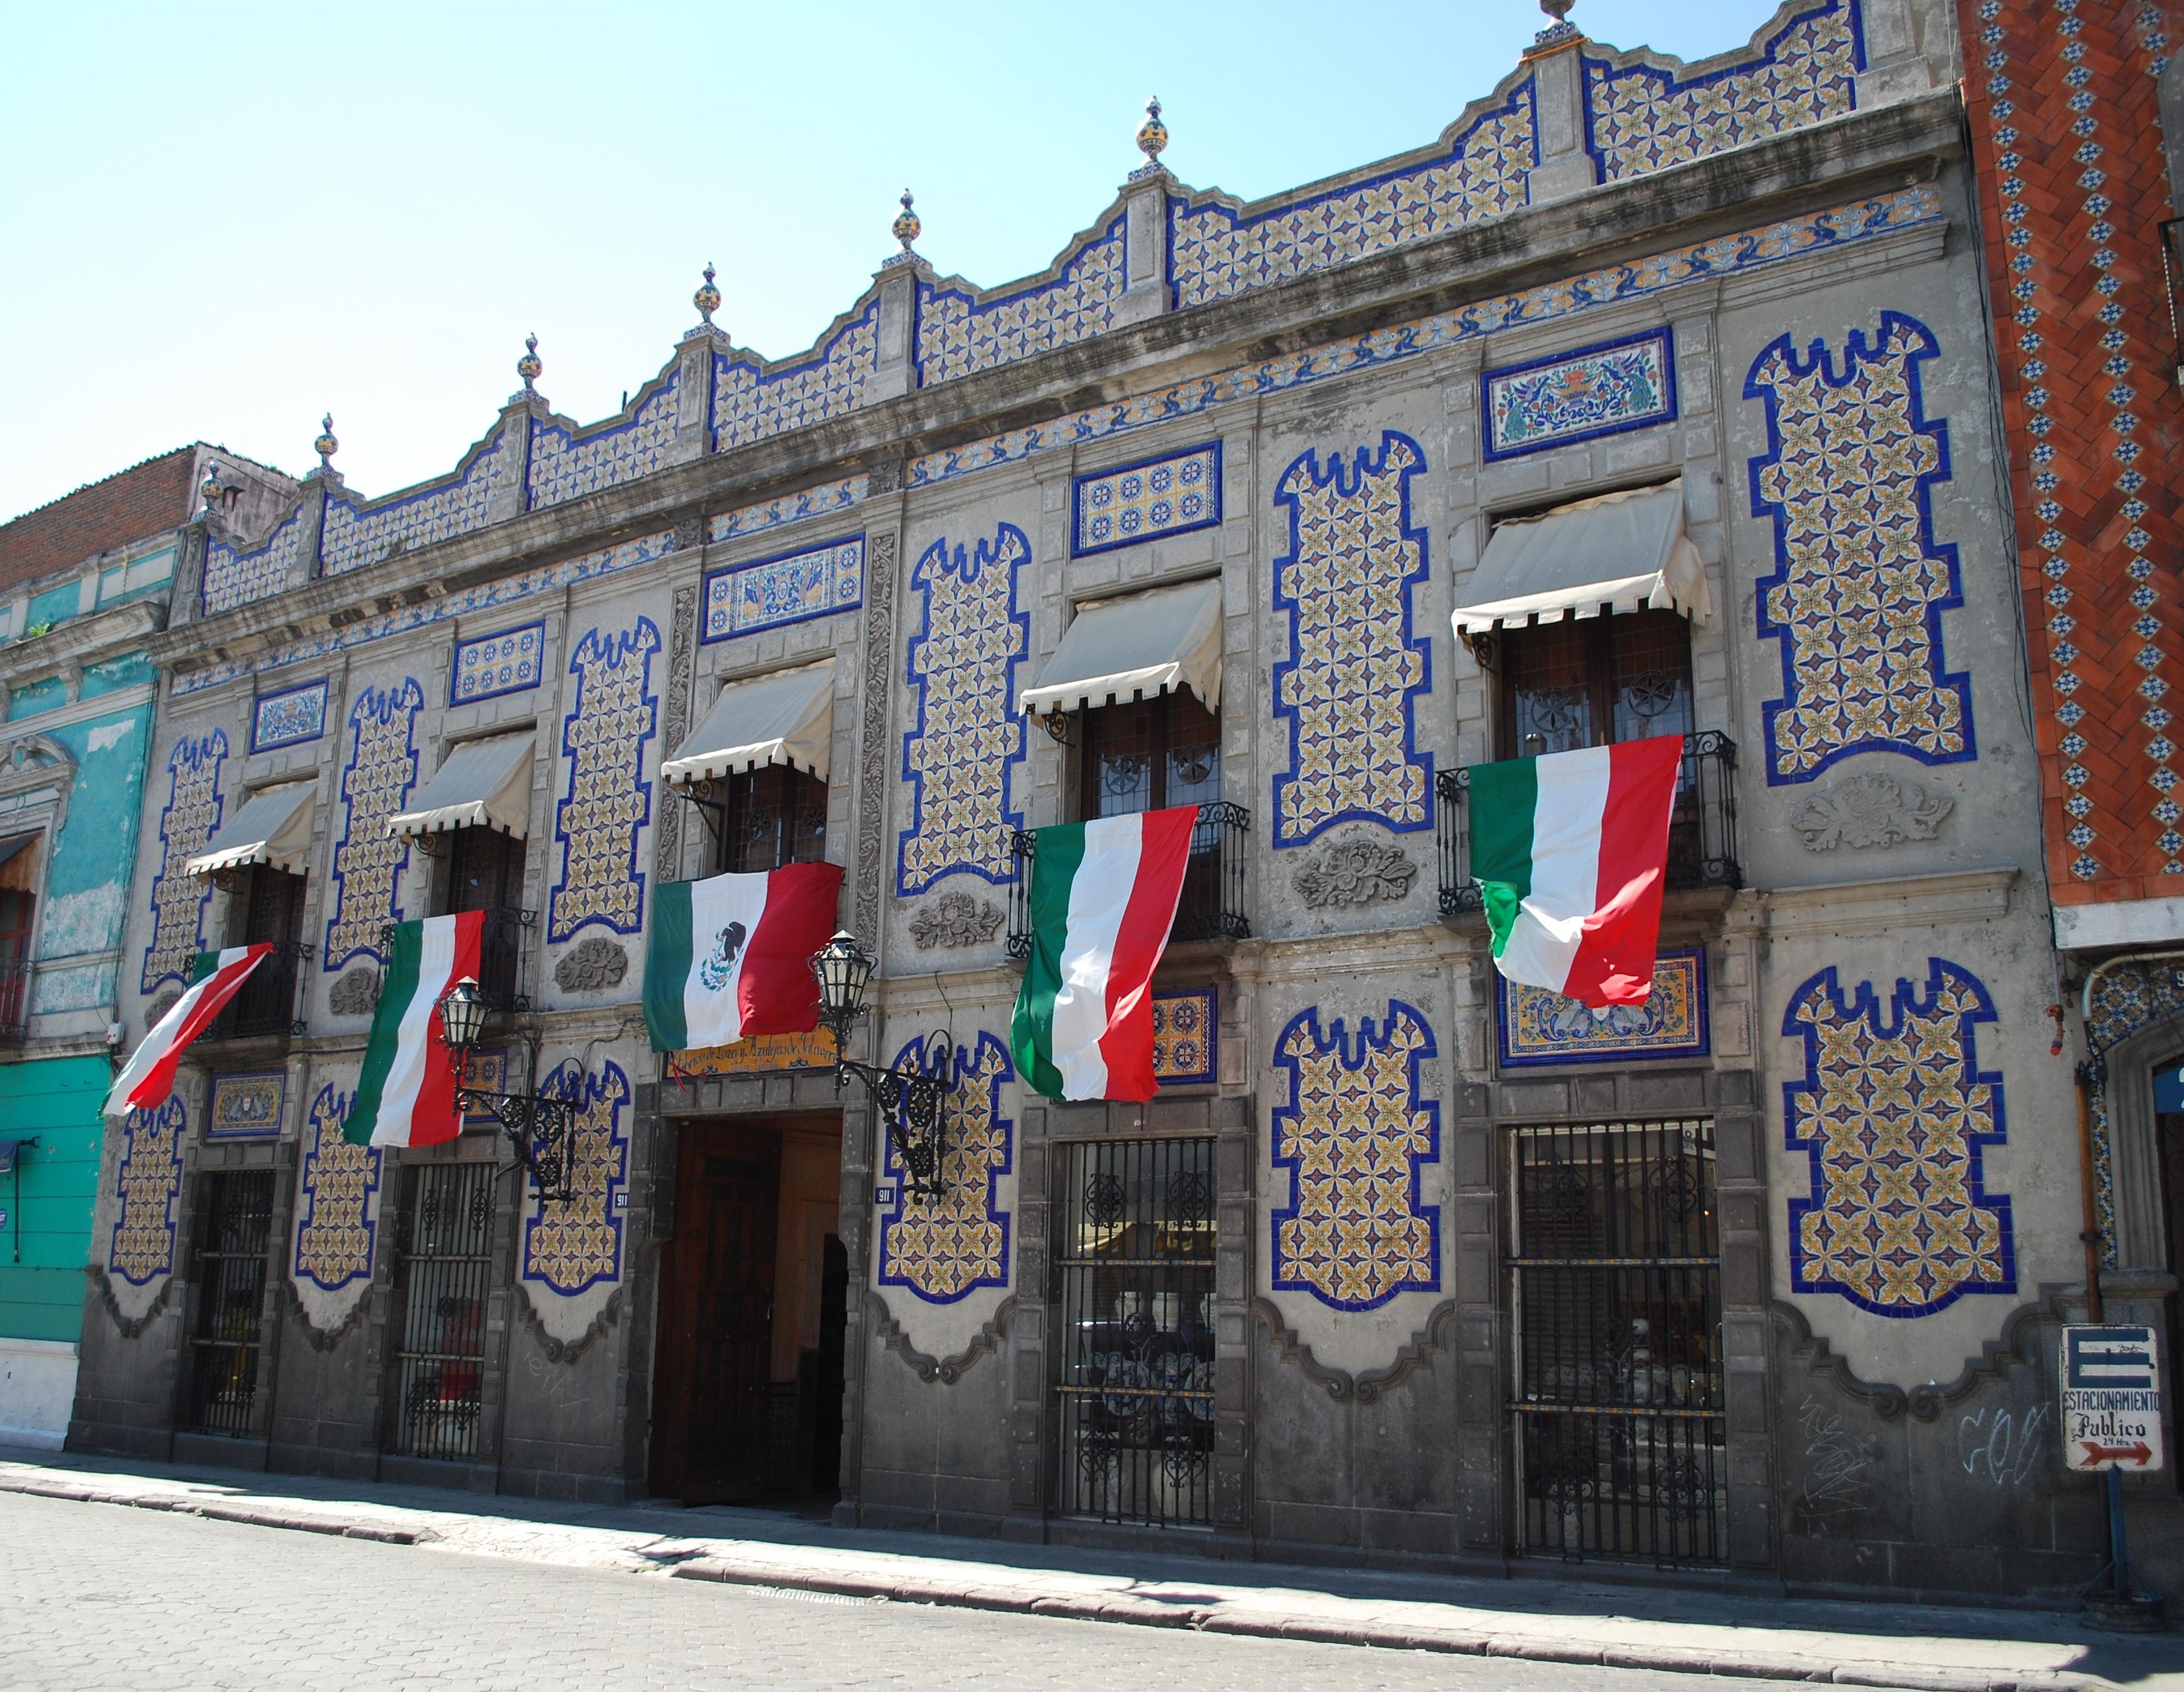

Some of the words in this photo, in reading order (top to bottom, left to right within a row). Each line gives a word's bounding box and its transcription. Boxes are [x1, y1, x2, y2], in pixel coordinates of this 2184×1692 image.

[617, 1195, 628, 1206] 911
[879, 1189, 890, 1202] 911
[2068, 1329, 2151, 1388] E
[2063, 1391, 2160, 1411] ESTACIONAMIENTO
